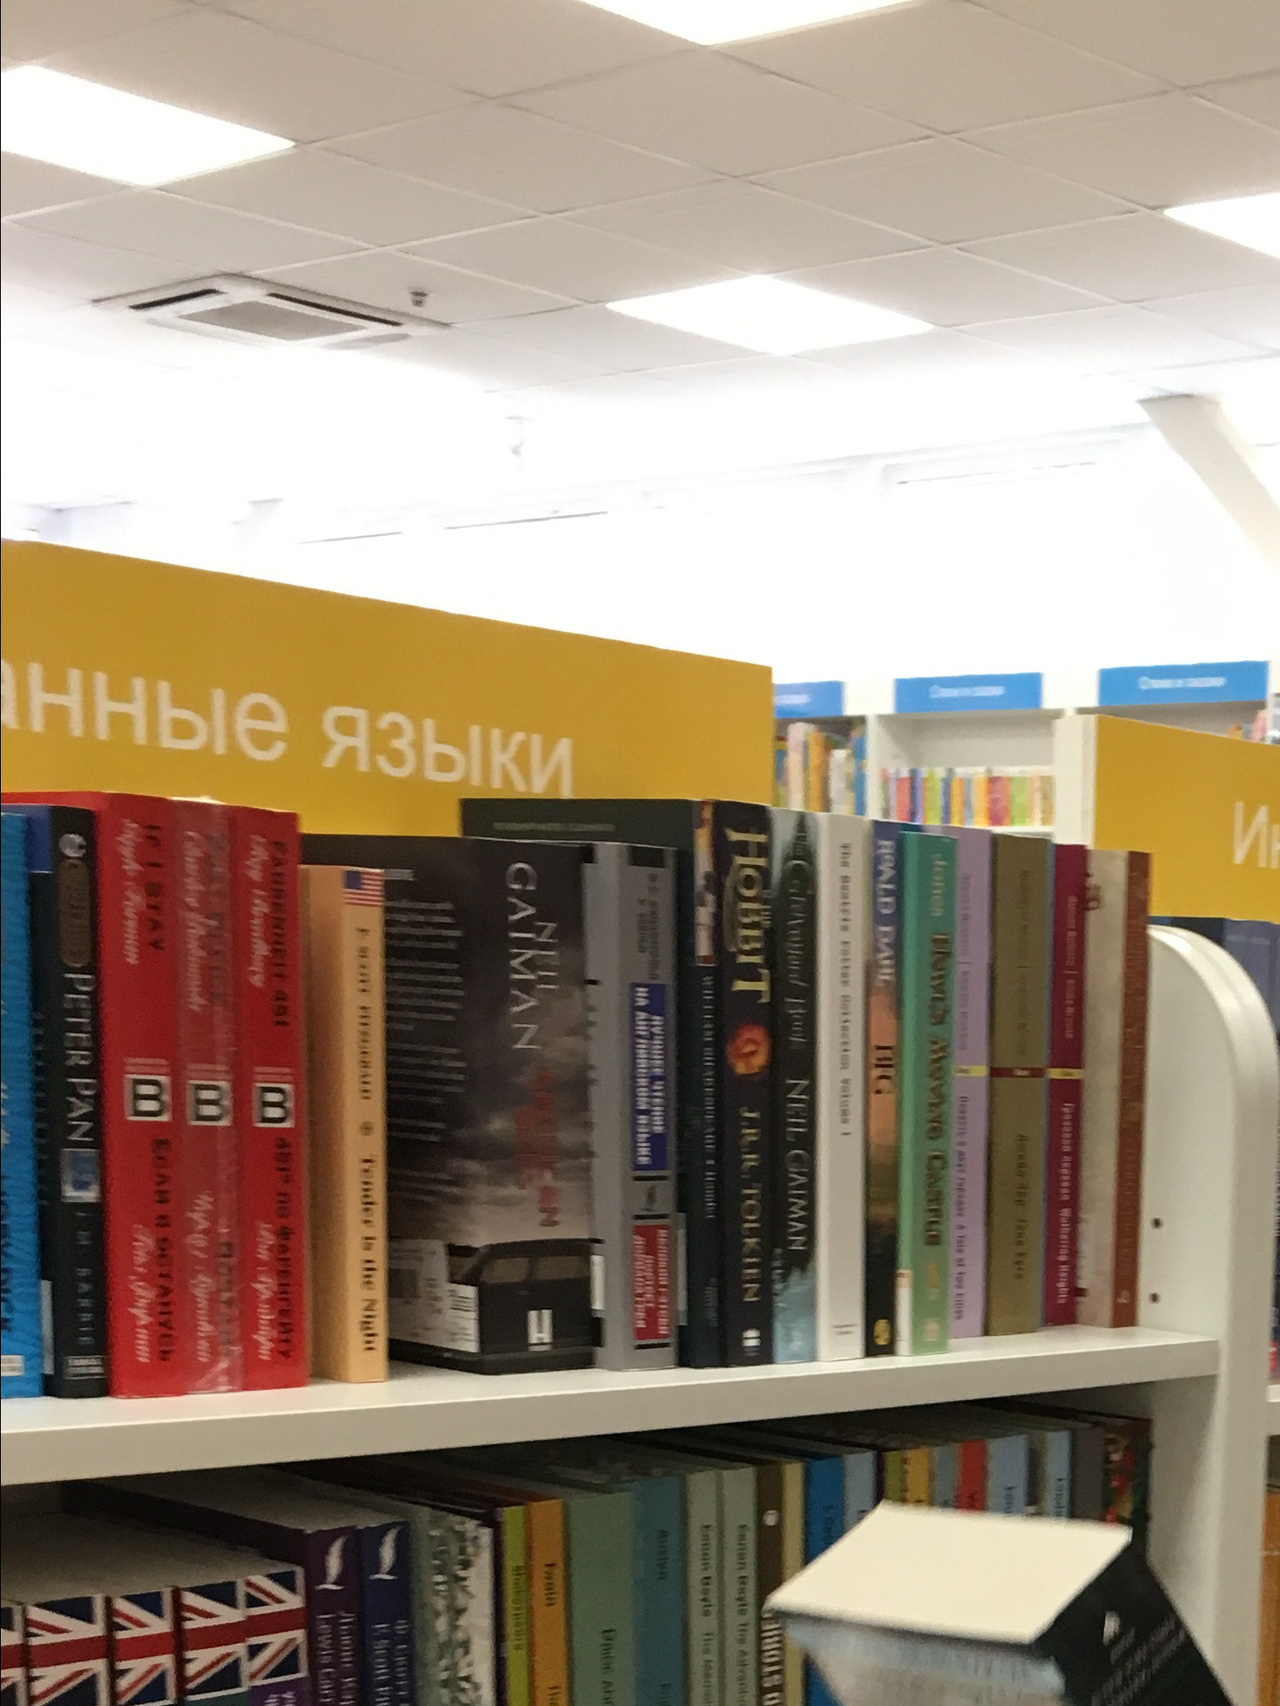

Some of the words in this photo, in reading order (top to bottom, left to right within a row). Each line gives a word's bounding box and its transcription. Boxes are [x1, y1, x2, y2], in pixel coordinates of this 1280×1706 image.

[320, 705, 573, 799] языки
[875, 838, 896, 915] ROALD
[145, 882, 166, 952] STAY
[270, 840, 290, 980] FAHRENHEIT
[505, 860, 542, 1048] GAIMAN
[534, 921, 560, 989] NEIL
[839, 940, 854, 988] Potter
[874, 924, 896, 987] DAHL
[63, 972, 96, 1066] PETER
[271, 988, 290, 1027] 451
[839, 994, 854, 1071] Collection
[65, 1077, 98, 1142] PAN
[784, 1079, 811, 1142] NEIL
[152, 1138, 173, 1205] ЕСЛИ
[360, 1156, 379, 1230] Tender
[784, 1149, 812, 1251] GAIMAN
[155, 1213, 172, 1228] Я
[740, 1182, 764, 1303] TOLKIEN
[1055, 1207, 1074, 1262] Wuthering
[156, 1237, 176, 1362] ОСТАНУСЬ
[274, 1224, 296, 1358] ФАРЕНГЕЙТУ
[1055, 1265, 1074, 1305] Heights
[358, 1298, 380, 1353] Night
[542, 1560, 561, 1608] Twain
[698, 1575, 716, 1618] Doyle
[734, 1575, 752, 1617] Doyle
[318, 1613, 340, 1662] Lewis
[373, 1640, 393, 1681] Scott
